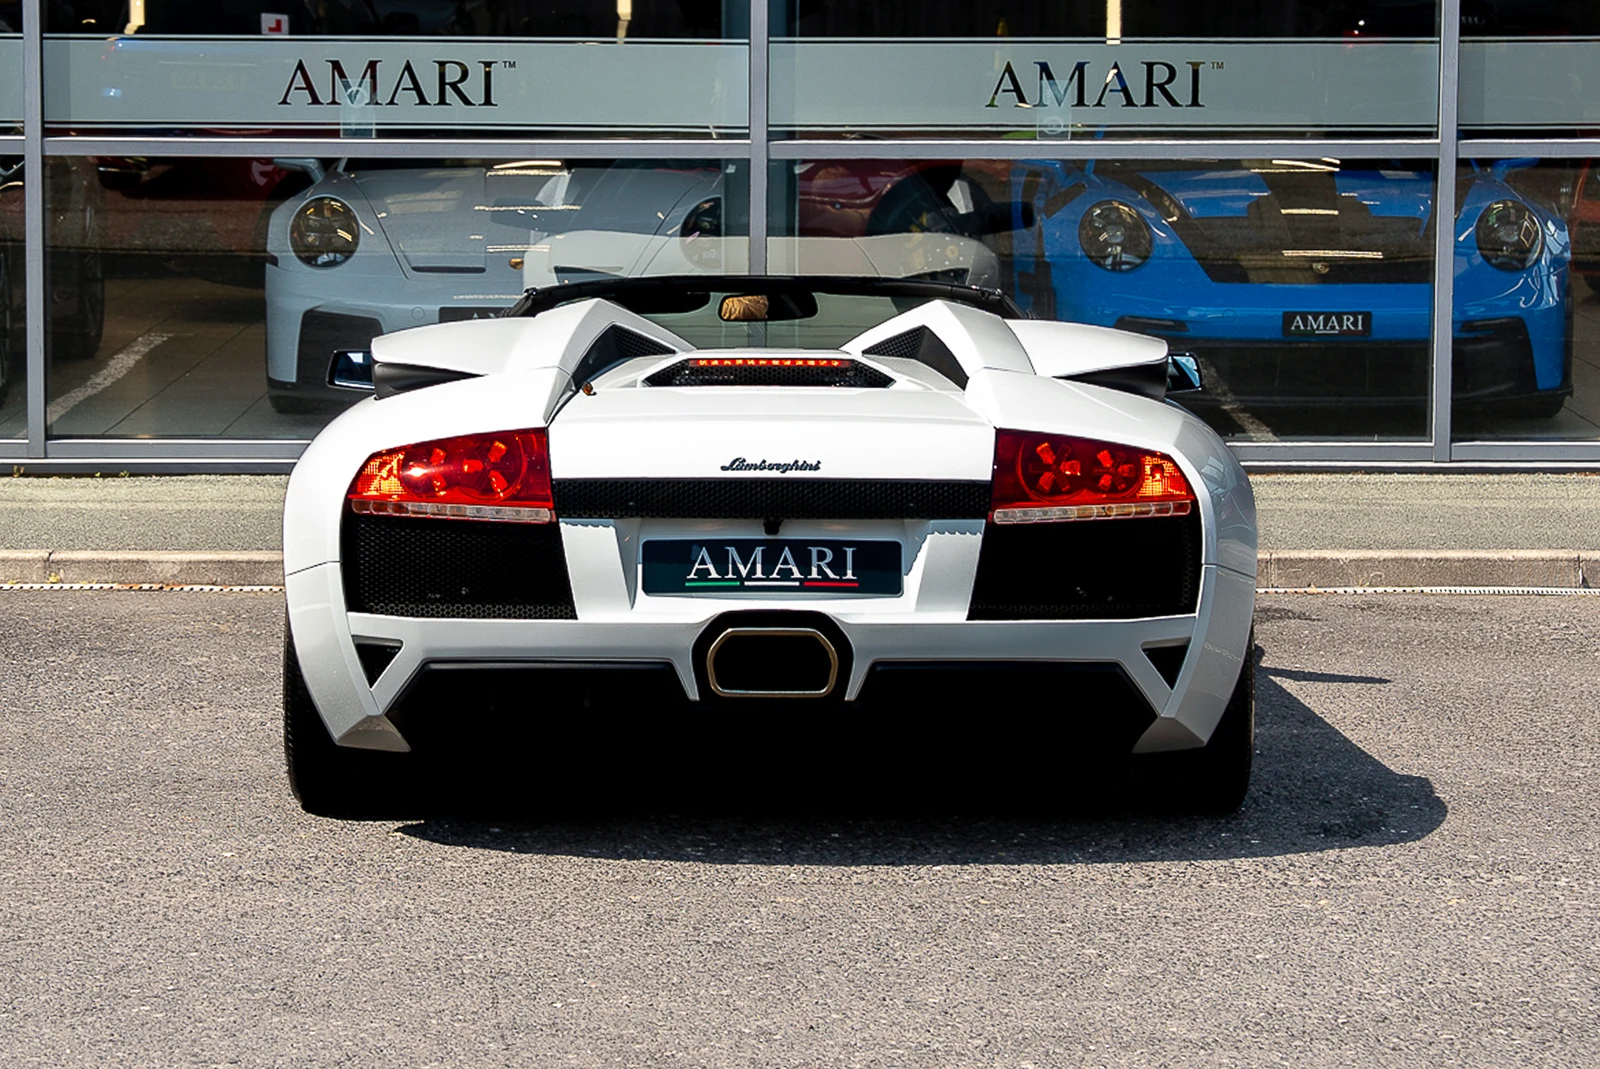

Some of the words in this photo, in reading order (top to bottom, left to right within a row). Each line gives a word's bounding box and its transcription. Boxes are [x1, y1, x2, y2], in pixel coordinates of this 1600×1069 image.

[277, 57, 499, 107] AMARI
[984, 60, 1206, 108] AMARI
[1290, 314, 1364, 331] AMARI
[720, 456, 822, 474] Lamborghini
[686, 546, 858, 580] AMARI
